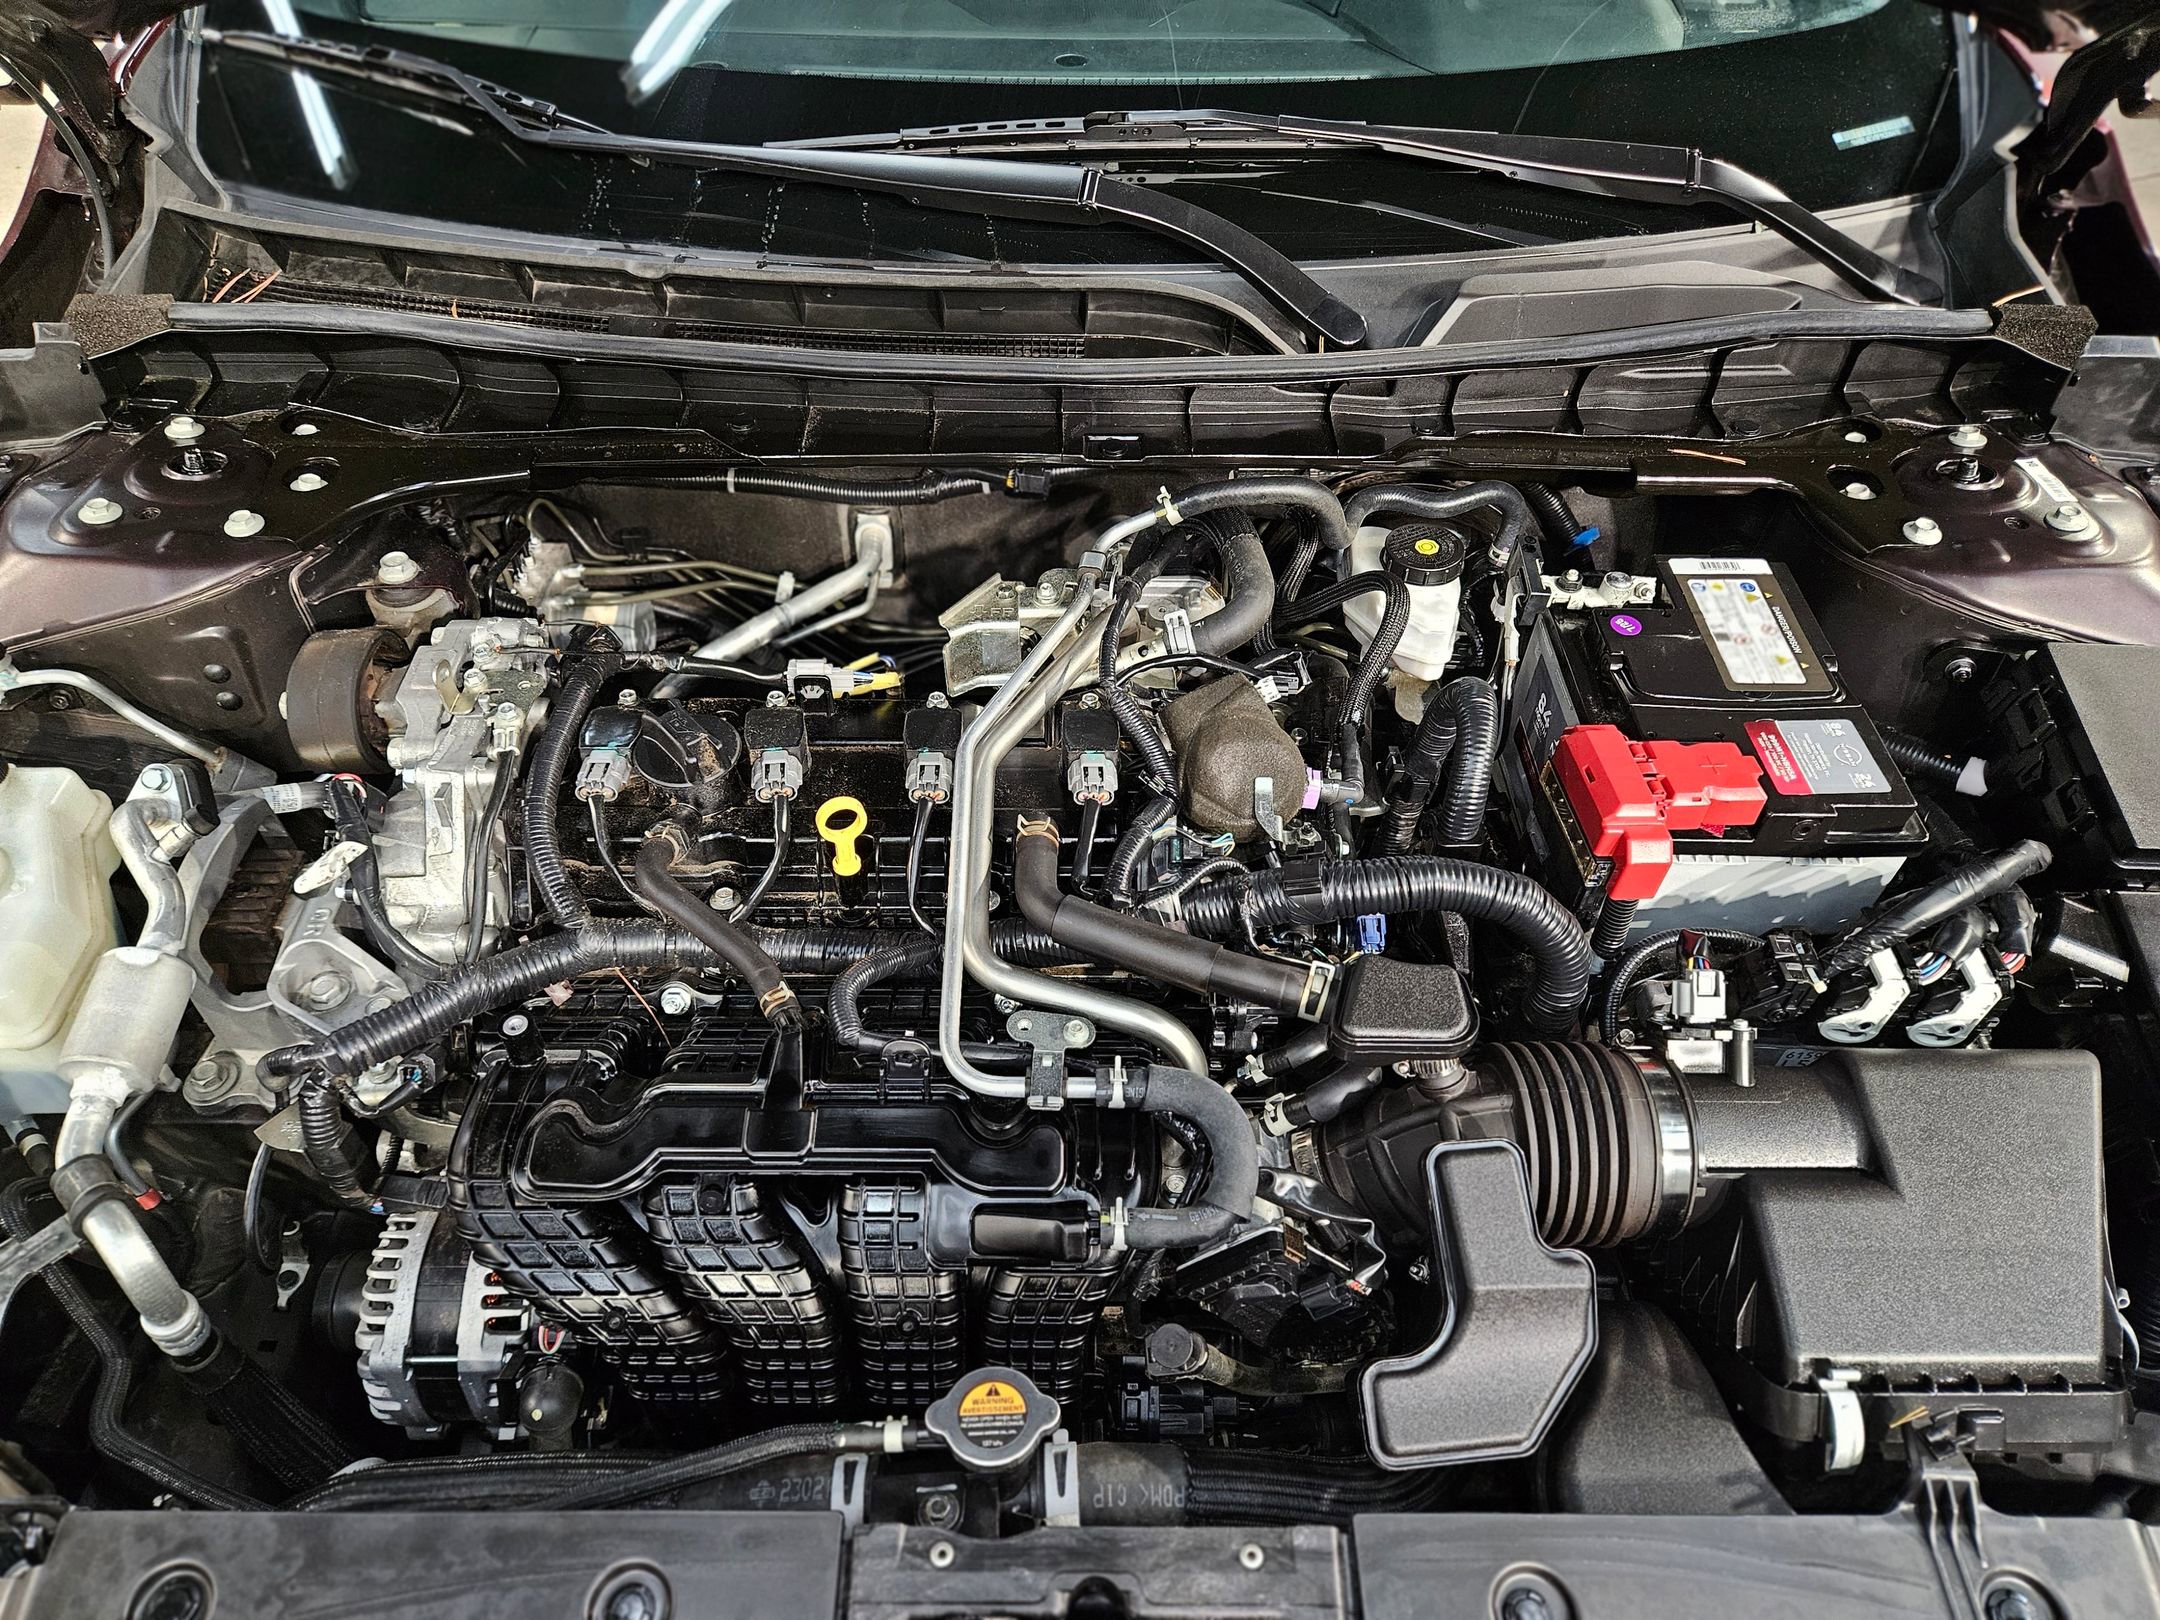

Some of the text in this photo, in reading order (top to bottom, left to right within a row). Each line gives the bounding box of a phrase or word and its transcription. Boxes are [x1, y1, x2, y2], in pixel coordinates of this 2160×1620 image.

[1772, 606, 1803, 654] DANGER/POISON
[972, 1396, 1014, 1405] WARNING
[962, 1404, 1024, 1413] AVERTISSEMENT
